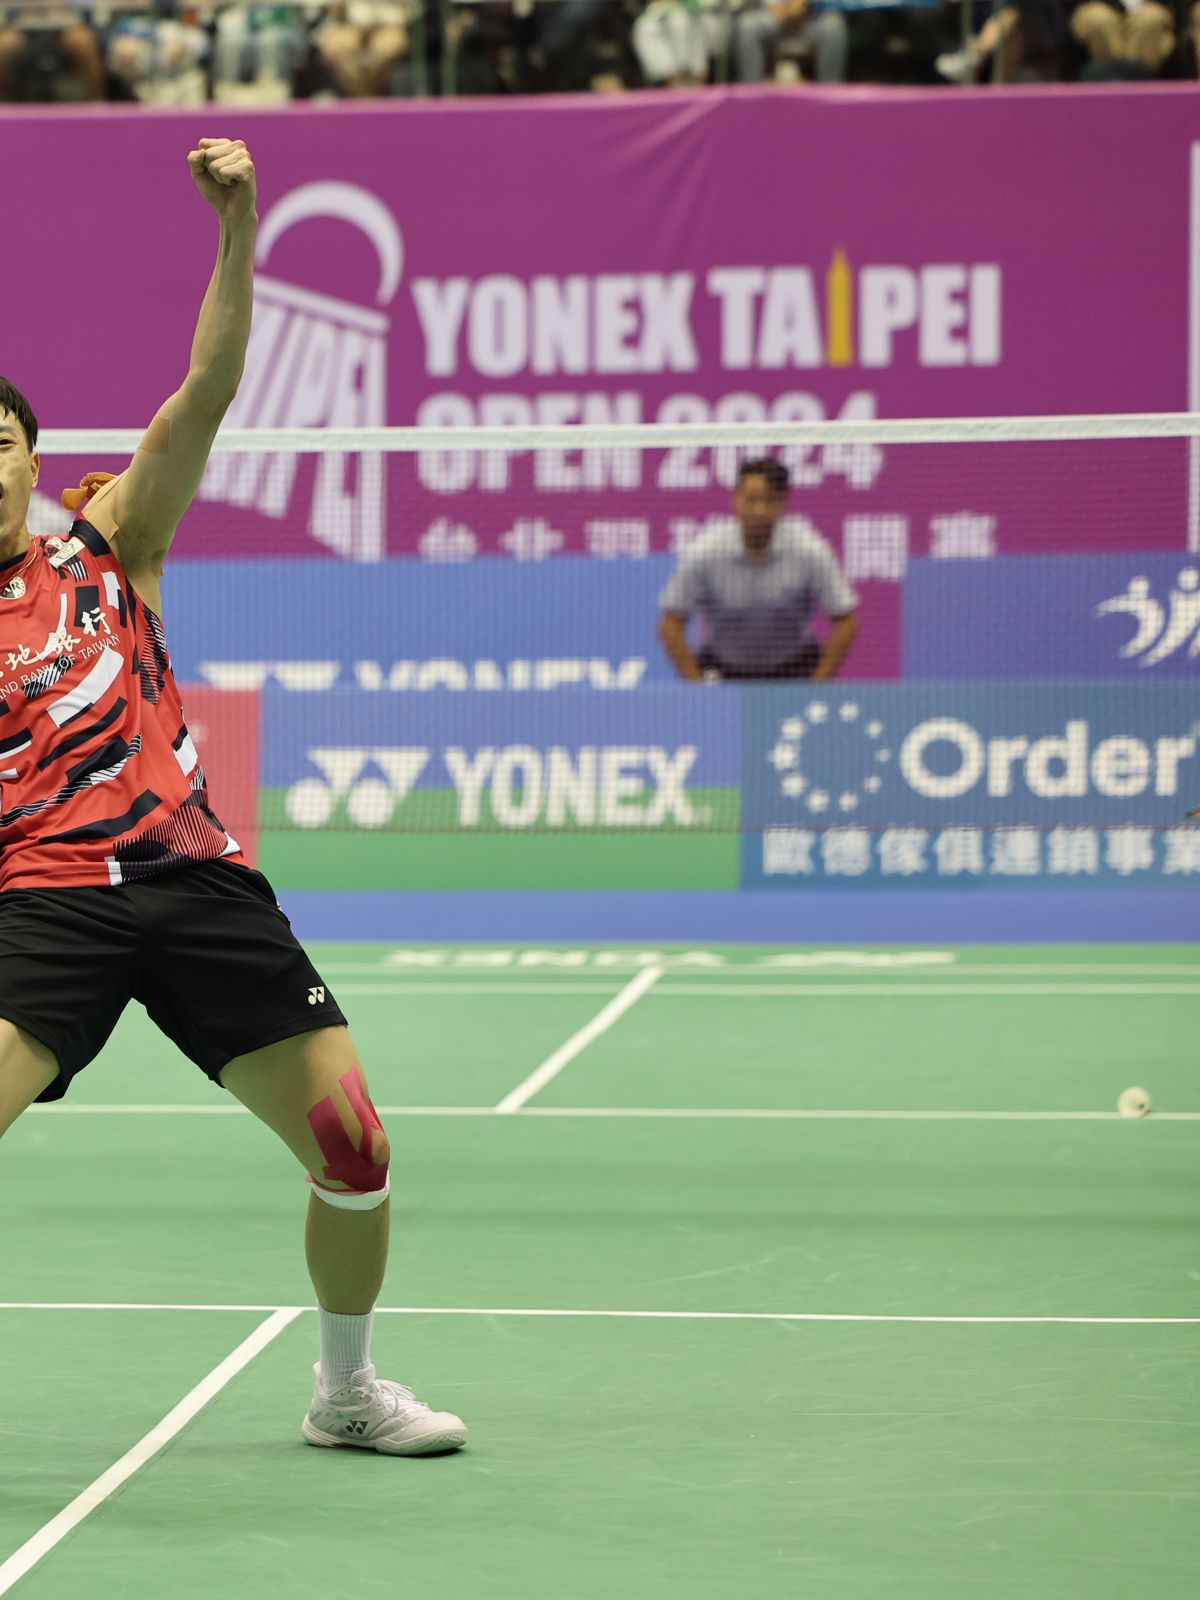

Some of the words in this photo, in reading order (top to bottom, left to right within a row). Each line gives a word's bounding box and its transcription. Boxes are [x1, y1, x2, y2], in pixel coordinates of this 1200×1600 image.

[410, 273, 699, 378] YONEX
[707, 247, 1001, 369] TAIPEI
[417, 392, 642, 494] OPEN
[656, 391, 884, 490] 2024
[19, 663, 56, 687] BANK
[58, 653, 77, 670] OF
[78, 633, 121, 661] TAIWAN
[443, 743, 698, 828] YONEX
